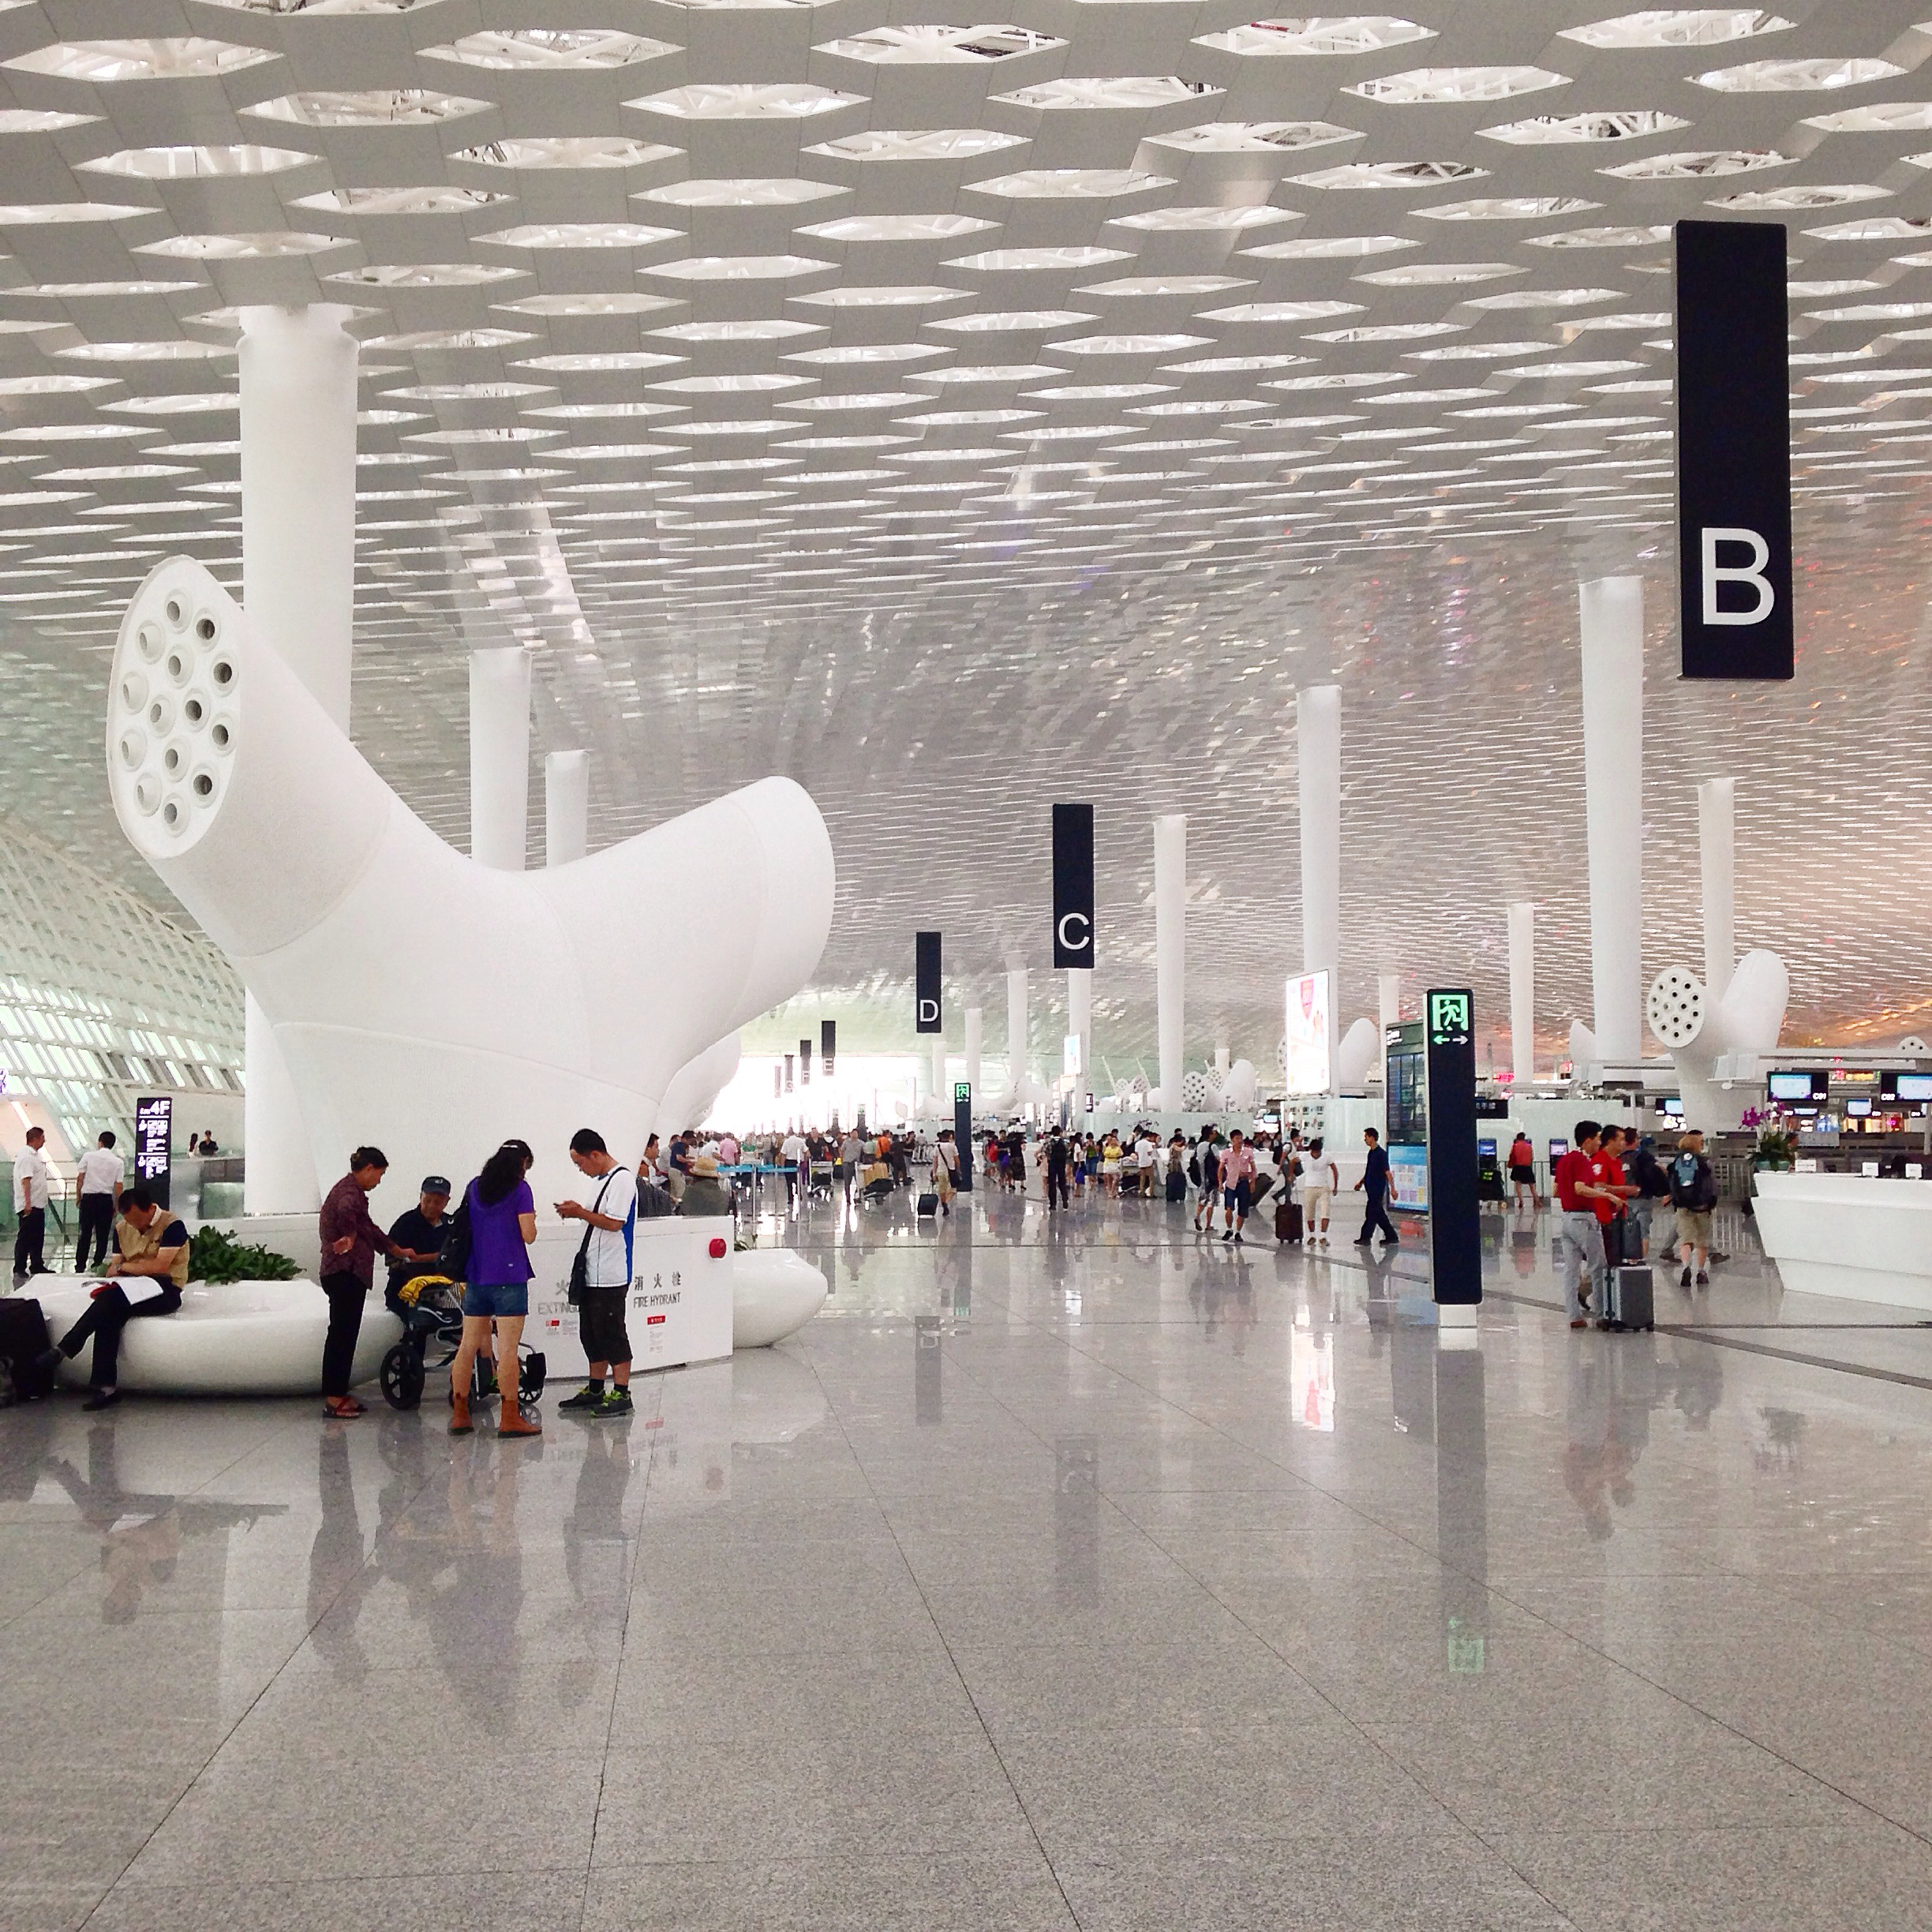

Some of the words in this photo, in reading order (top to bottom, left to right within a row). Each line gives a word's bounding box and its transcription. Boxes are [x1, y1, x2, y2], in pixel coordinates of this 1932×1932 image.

[1701, 527, 1775, 626] B
[1058, 912, 1090, 950] C
[919, 999, 939, 1022] D
[822, 1058, 833, 1072] E
[150, 1100, 170, 1115] 4F
[633, 1296, 649, 1309] FIRE
[650, 1292, 681, 1306] HYDRANT
